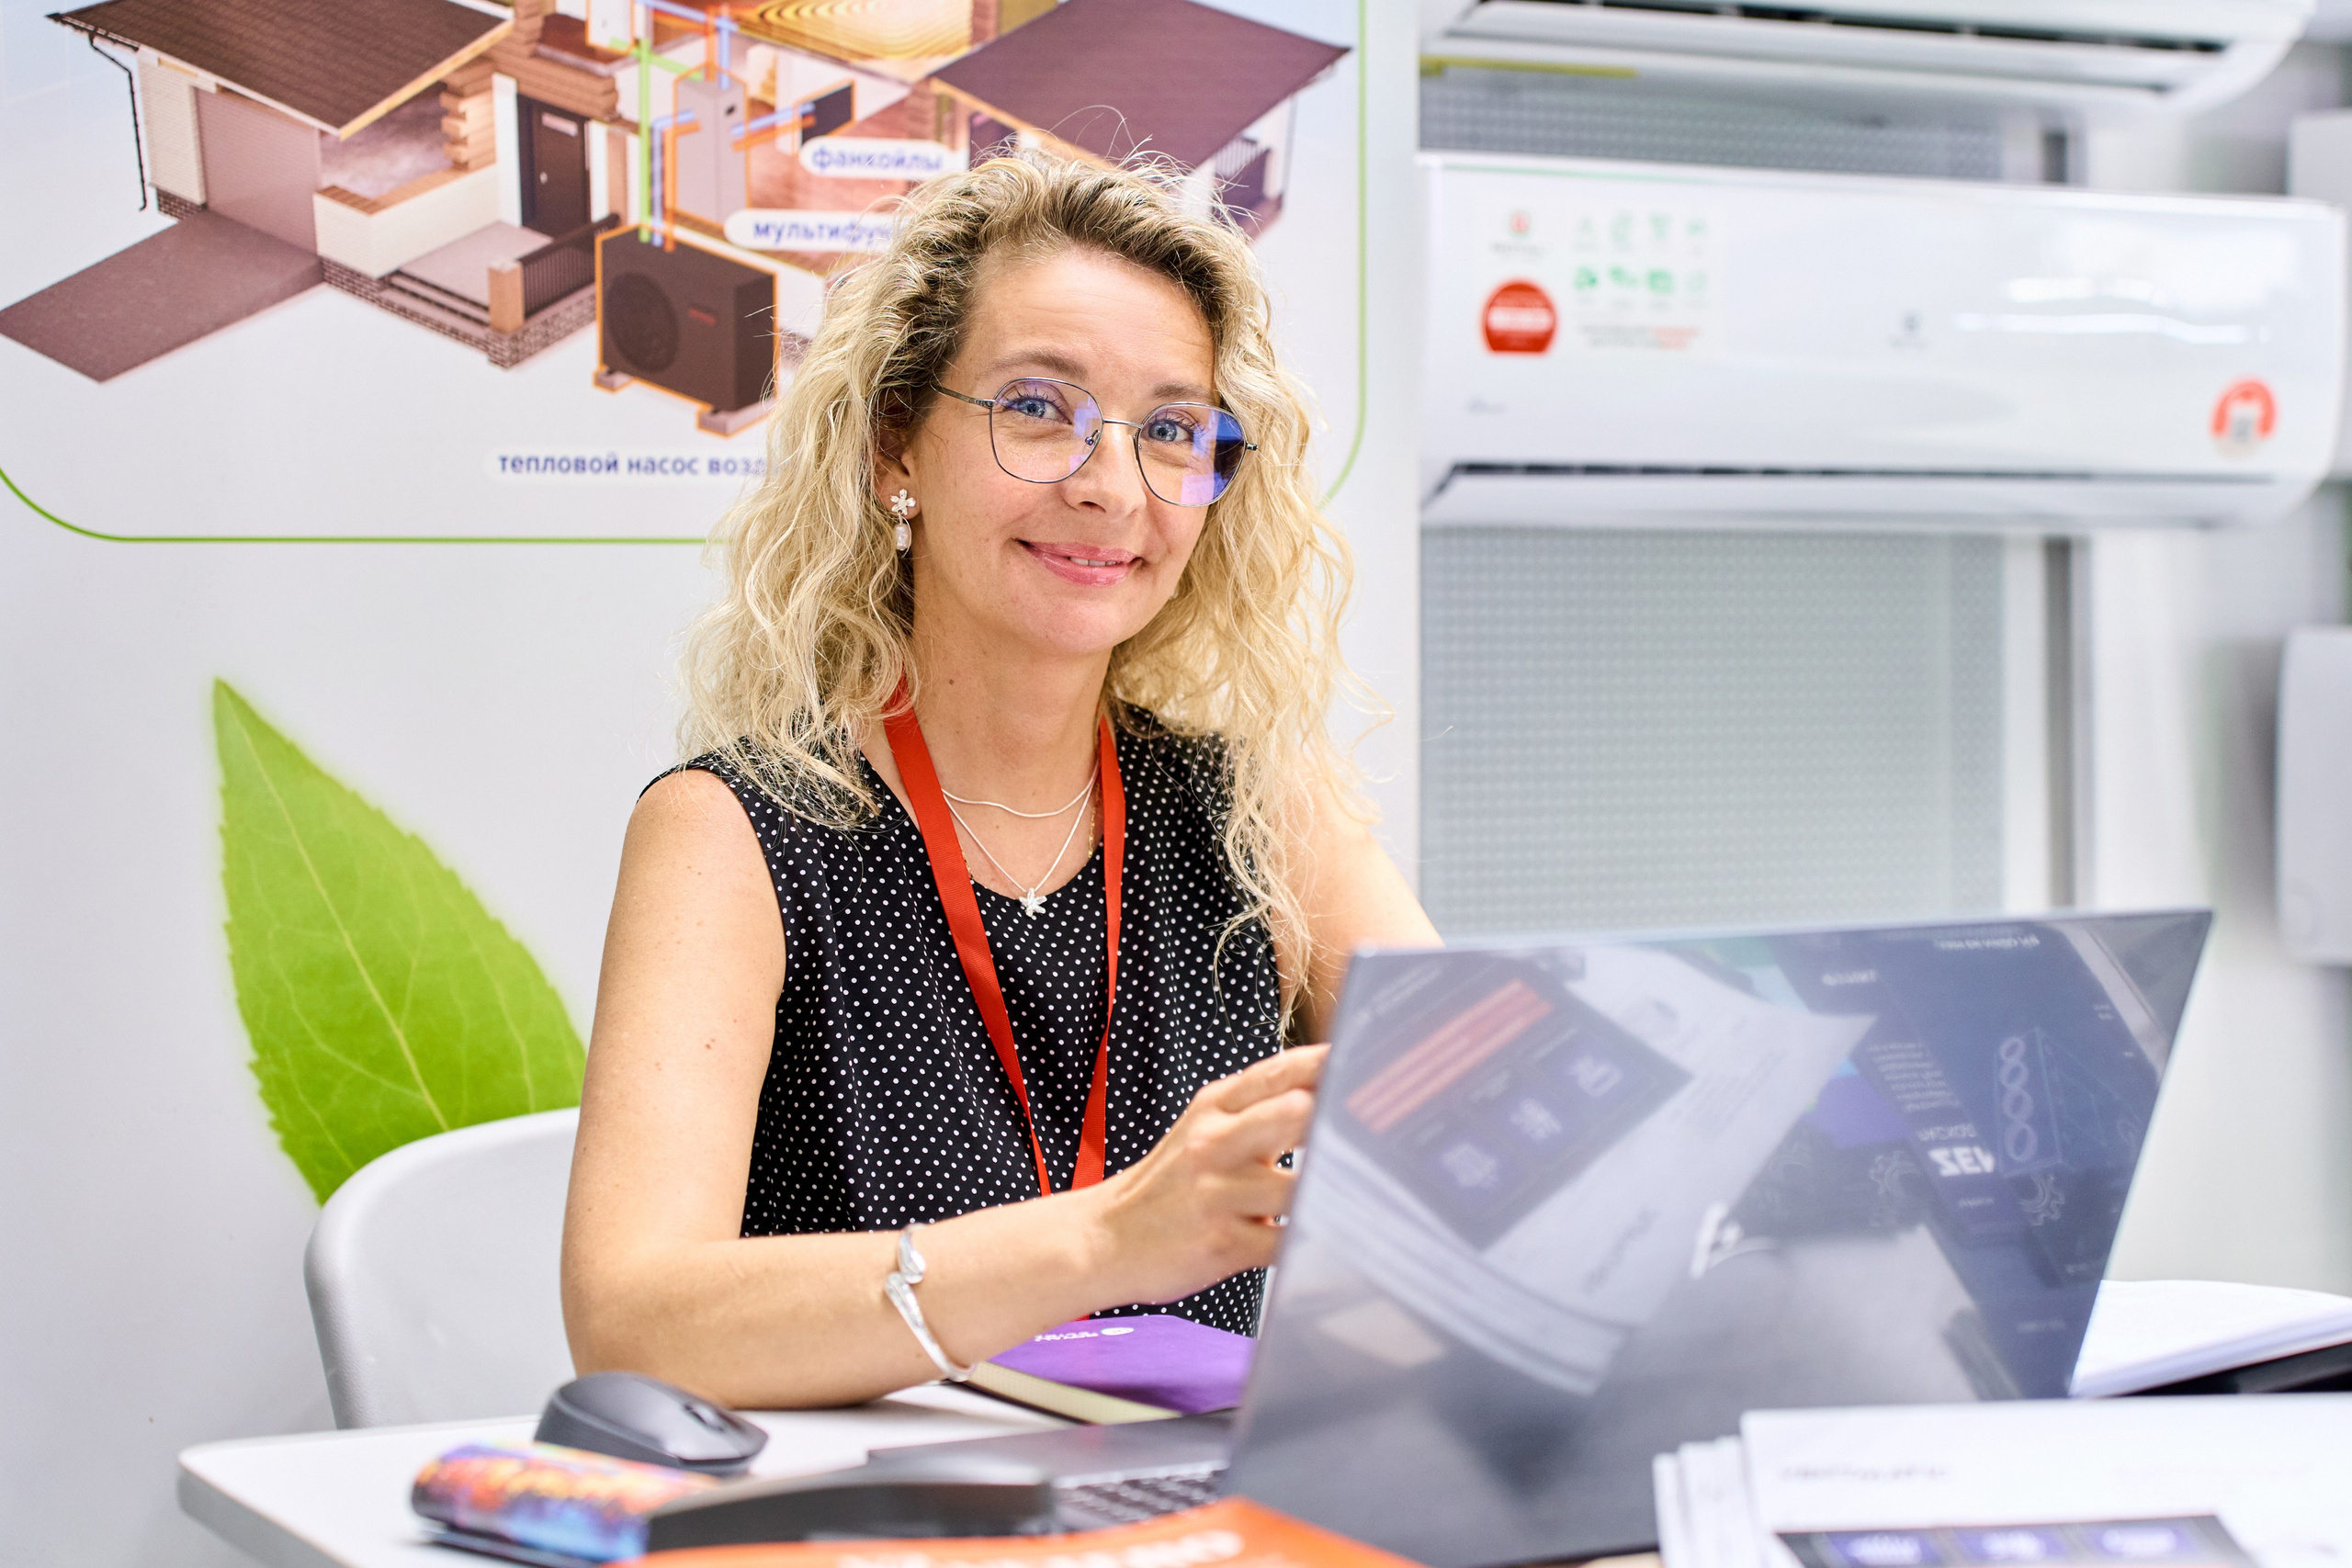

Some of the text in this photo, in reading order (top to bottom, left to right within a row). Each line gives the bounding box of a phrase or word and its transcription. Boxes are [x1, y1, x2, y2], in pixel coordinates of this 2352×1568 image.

[811, 145, 943, 172] фанкойлы
[753, 221, 896, 244] мультифун
[499, 451, 768, 477] тепловой насос возд
